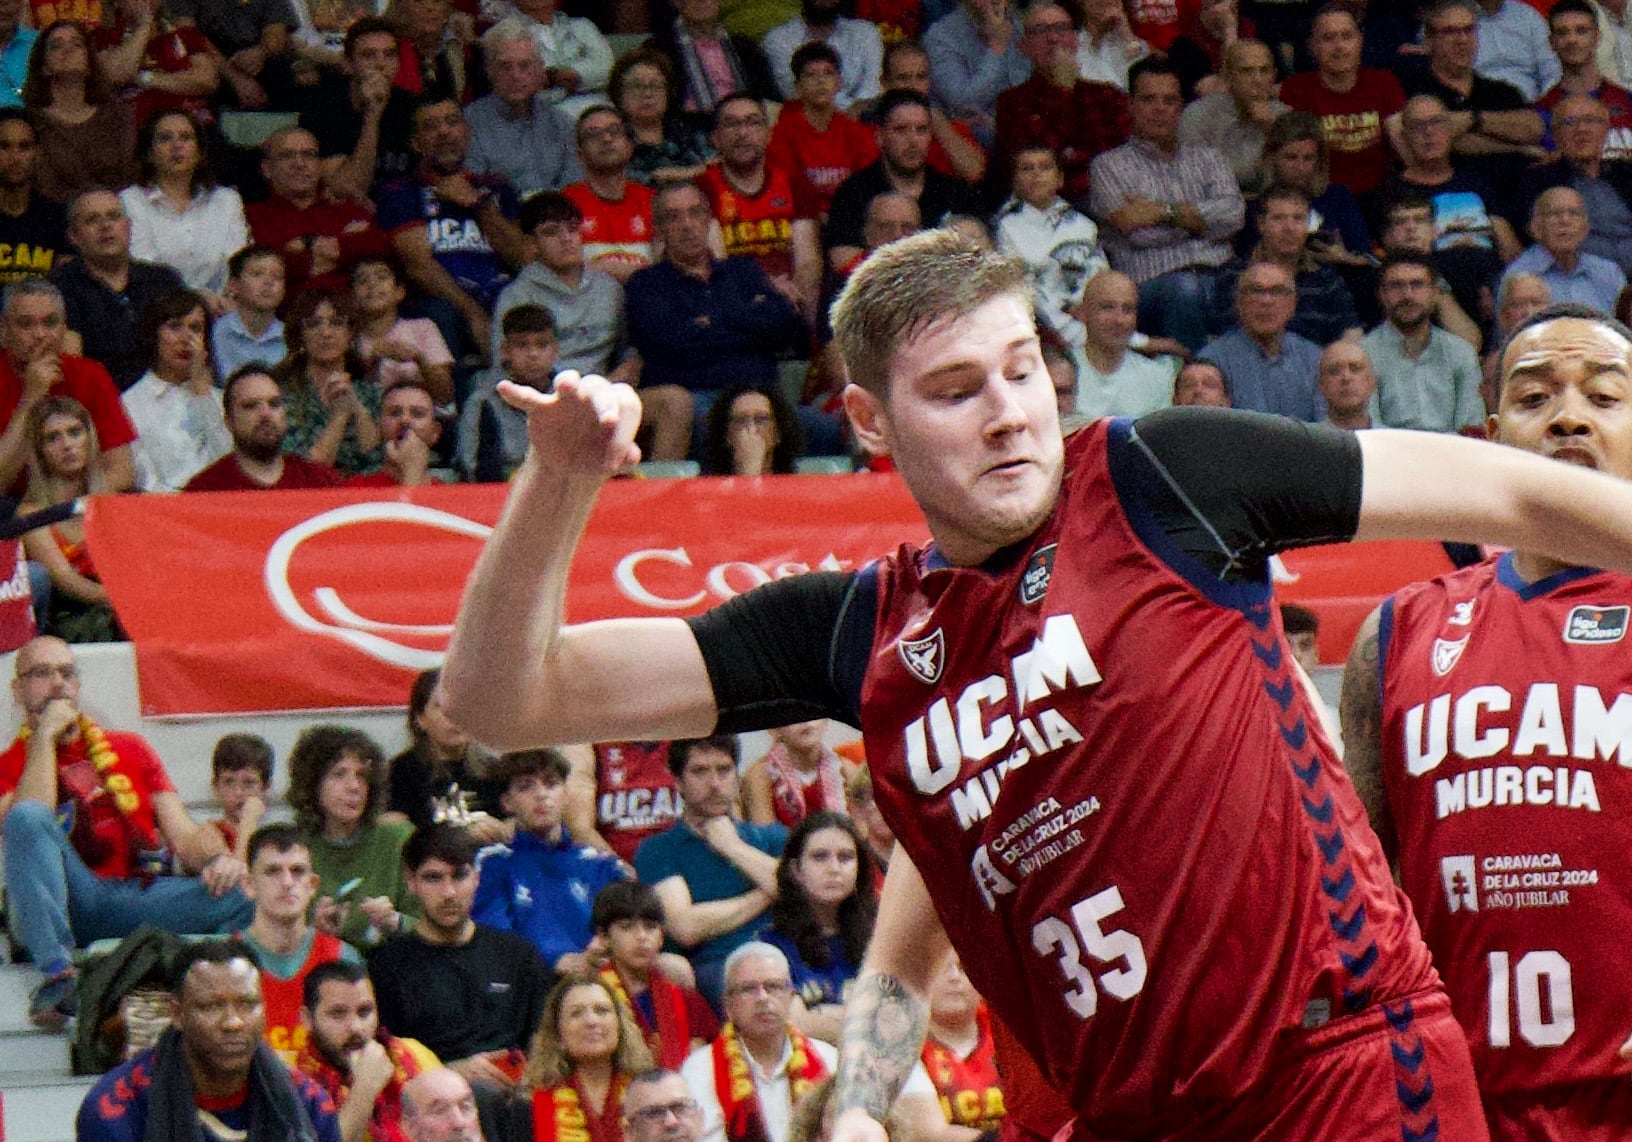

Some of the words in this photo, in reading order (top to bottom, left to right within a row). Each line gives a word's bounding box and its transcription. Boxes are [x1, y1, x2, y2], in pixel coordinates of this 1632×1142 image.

[1436, 765, 1602, 819] MURCIA
[1483, 853, 1561, 870] CARAVACA
[1485, 874, 1502, 889] DE
[1504, 874, 1520, 888] LA
[1523, 872, 1560, 886] CRUZ
[1562, 869, 1598, 885] 2024
[1487, 890, 1513, 908] AÑO
[1516, 890, 1570, 909] JUBILAR
[1031, 885, 1148, 1020] 35
[1488, 951, 1575, 1047] 10
